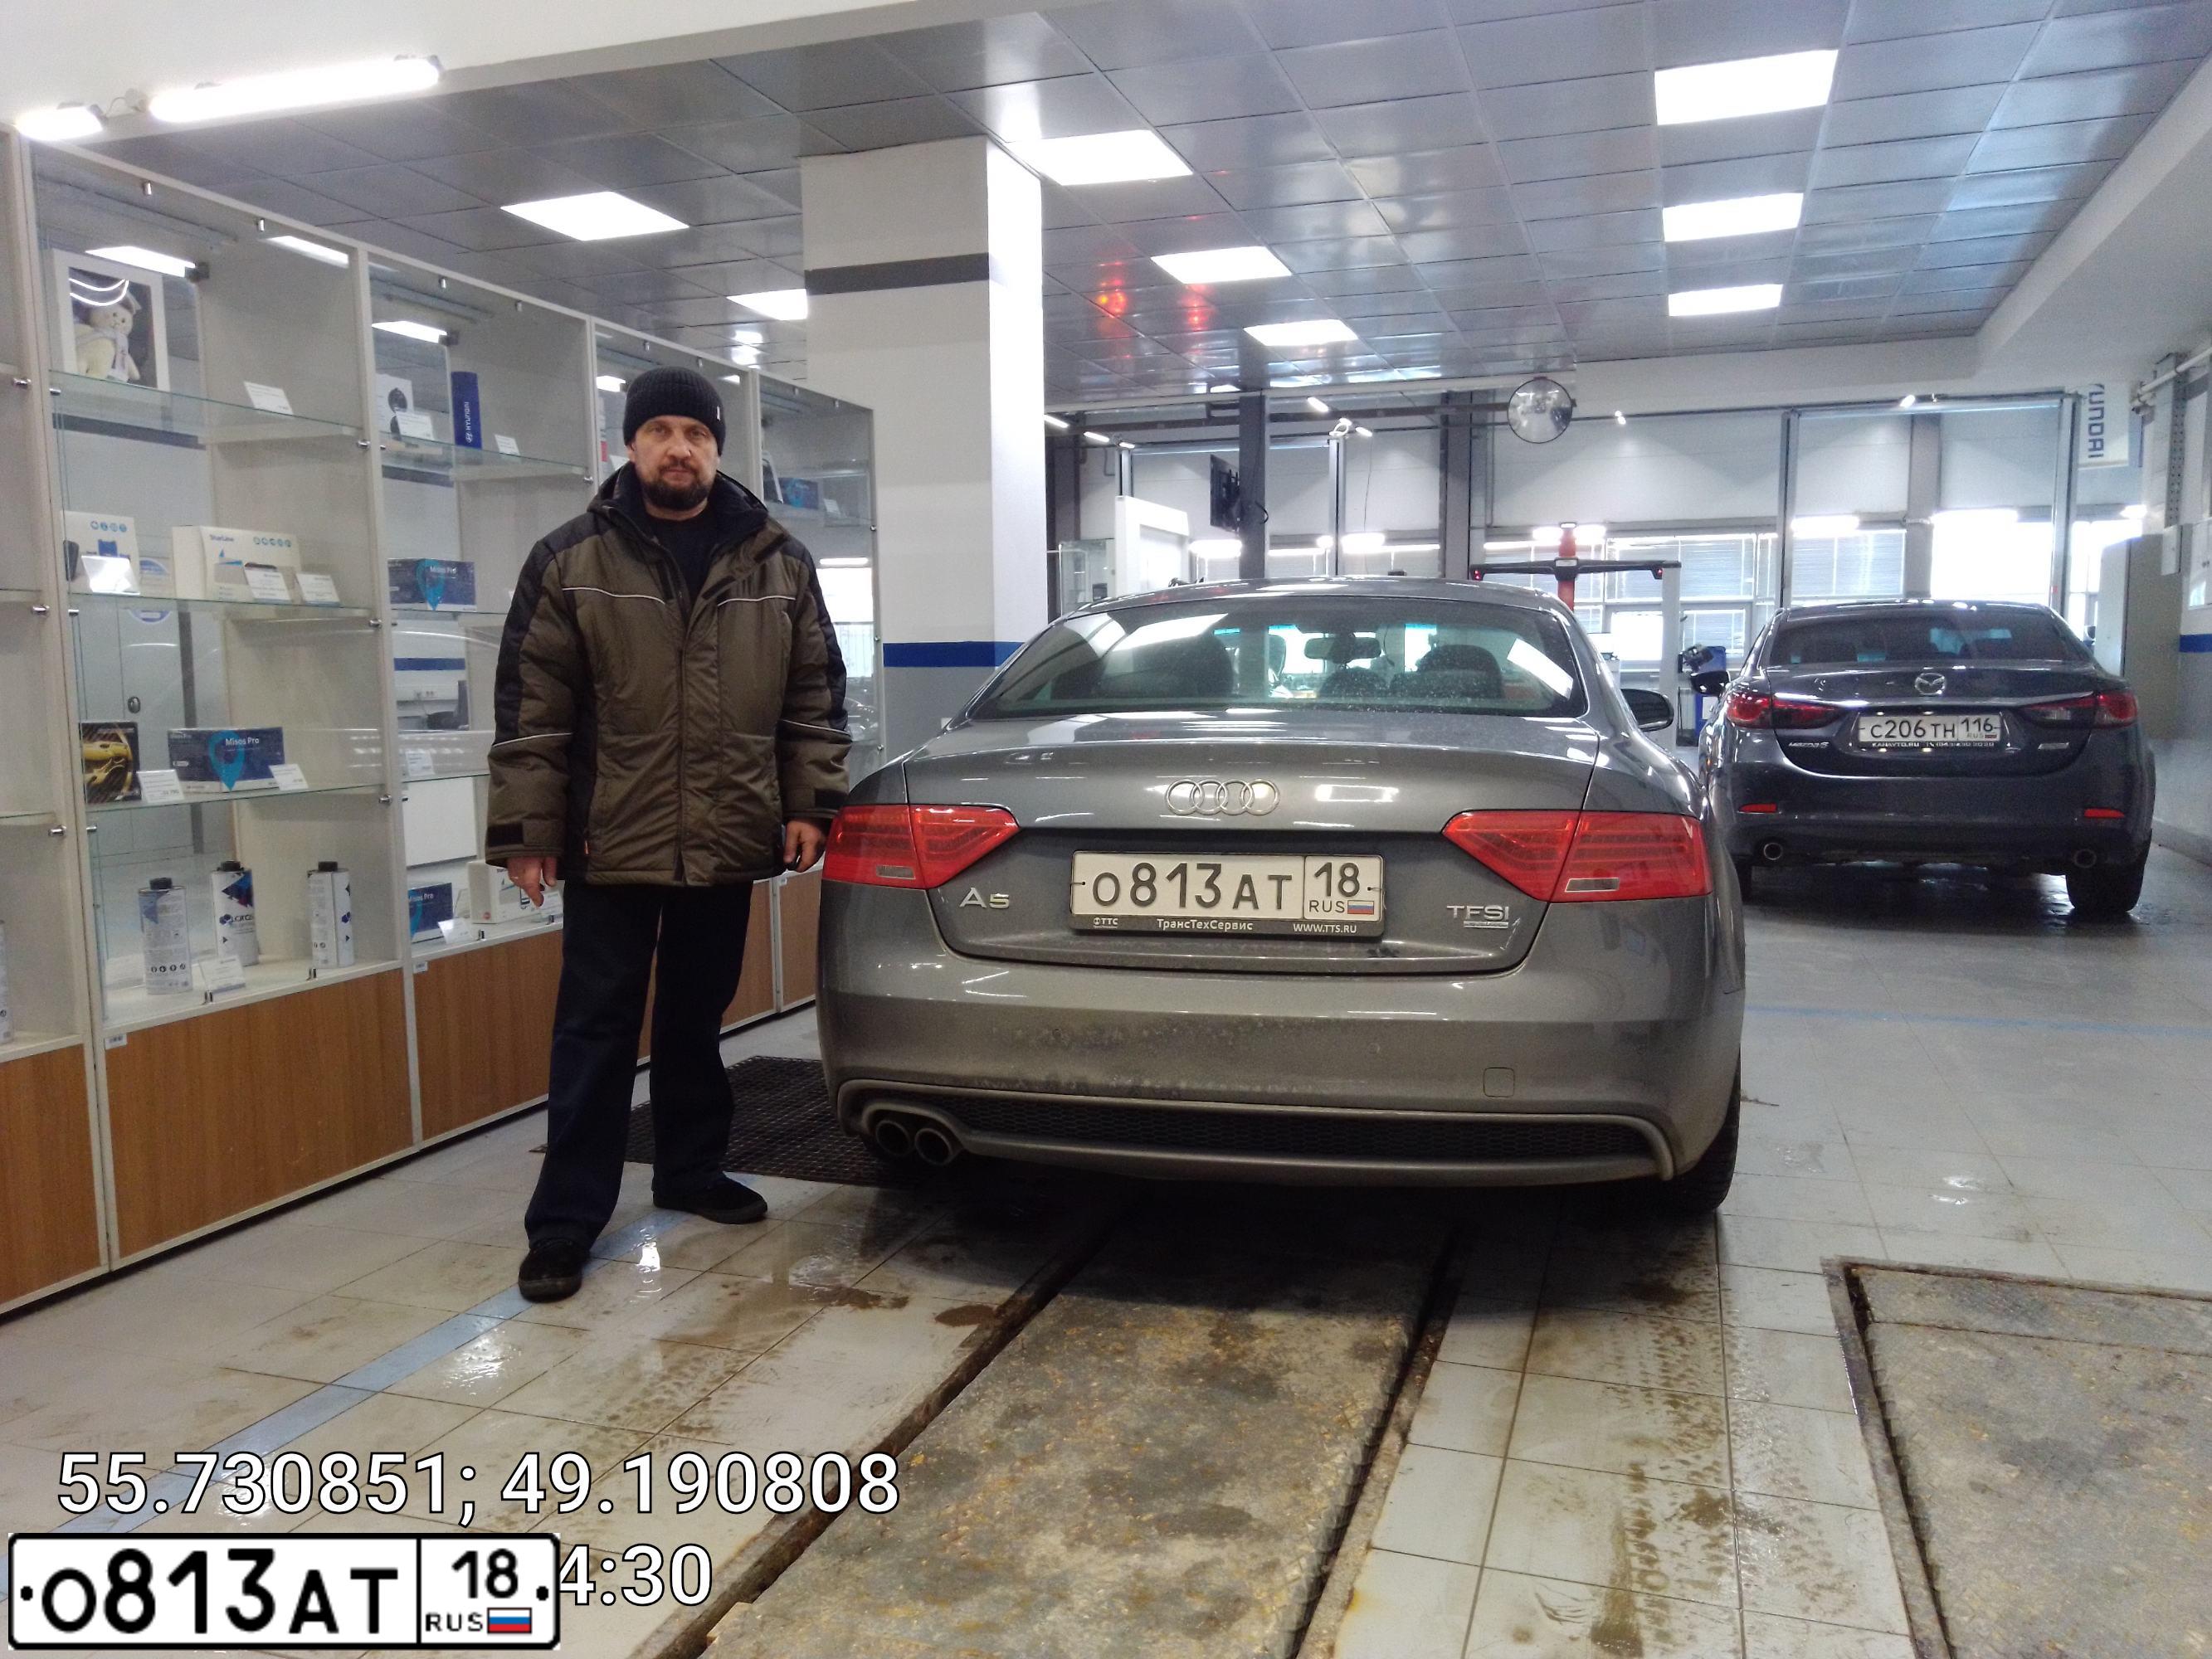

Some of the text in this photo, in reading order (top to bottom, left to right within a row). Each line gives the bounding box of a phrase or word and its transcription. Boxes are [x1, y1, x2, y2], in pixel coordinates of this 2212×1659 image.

[1870, 718, 1993, 739] С206ТН 116
[1092, 862, 1360, 909] О813АТ 18
[959, 887, 1010, 909] A5
[1308, 899, 1345, 913] RUS
[1446, 905, 1509, 921] TFSI
[1157, 918, 1254, 932] ТрансТехСервис
[1293, 923, 1357, 933] WWW.TTS.RU
